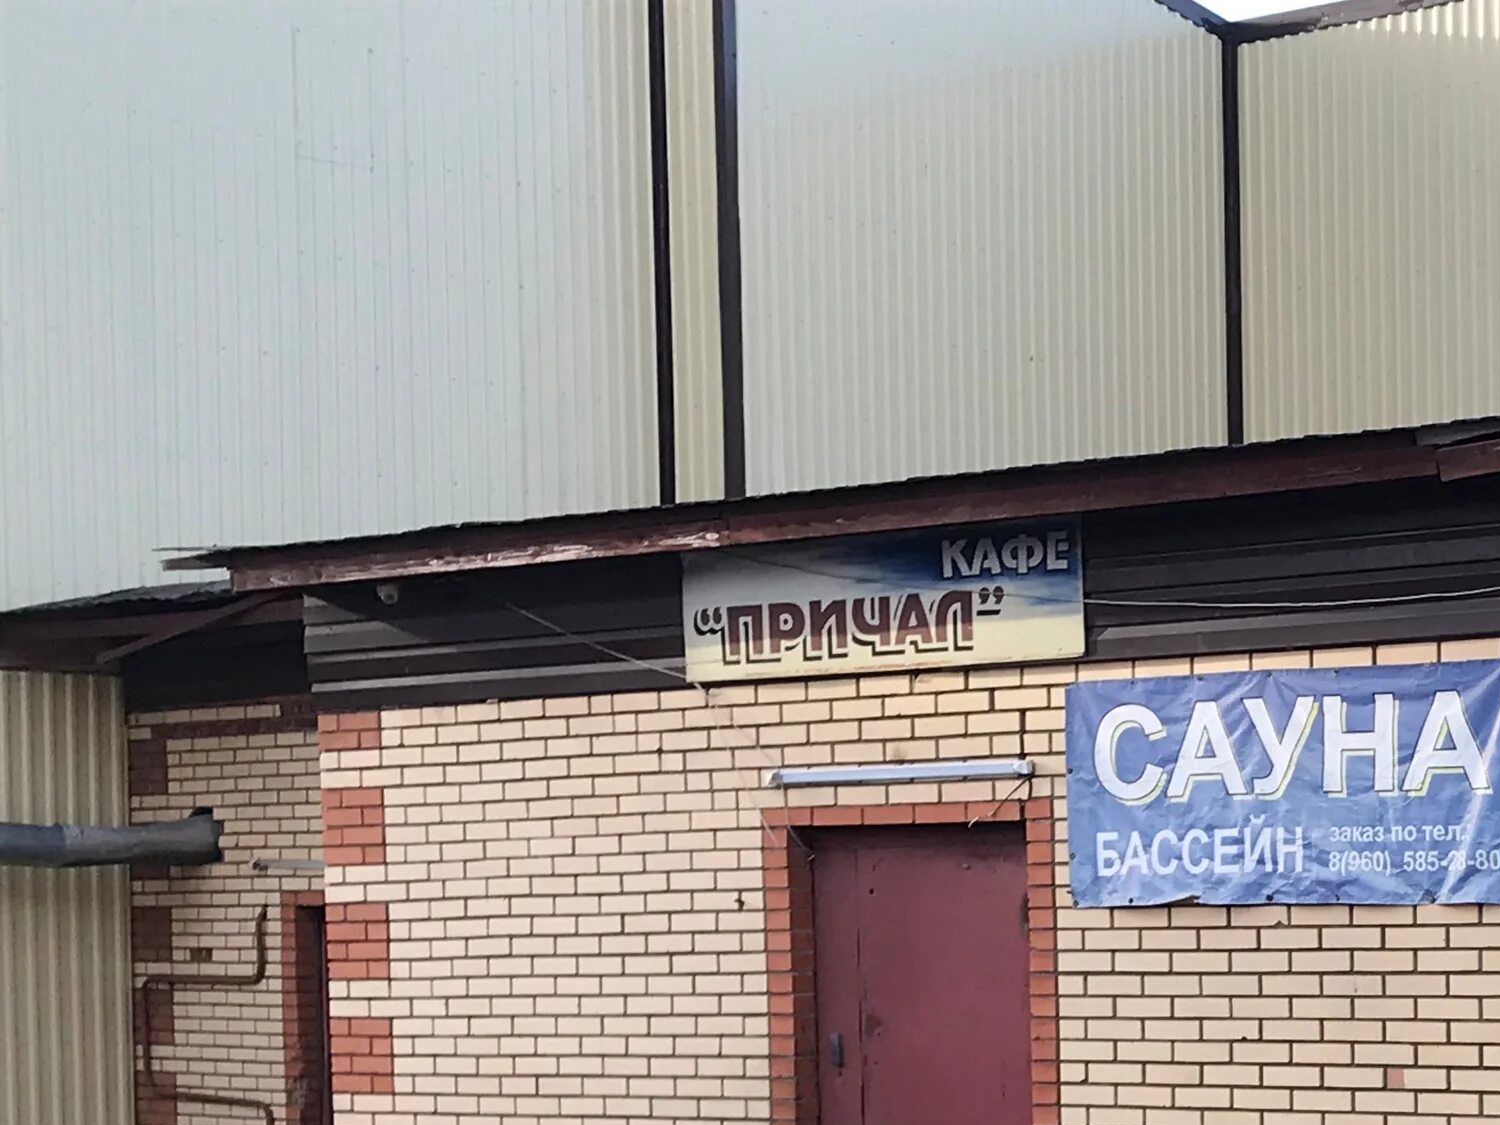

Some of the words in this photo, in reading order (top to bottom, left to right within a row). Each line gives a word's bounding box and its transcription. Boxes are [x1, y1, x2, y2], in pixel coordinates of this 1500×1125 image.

[941, 531, 1069, 578] КАФЕ
[1094, 690, 1492, 804] САУНА
[1096, 814, 1303, 876] БАССЕЙН
[1329, 825, 1384, 842] заказ
[1391, 826, 1416, 842] по
[1328, 851, 1391, 876] 8(960)
